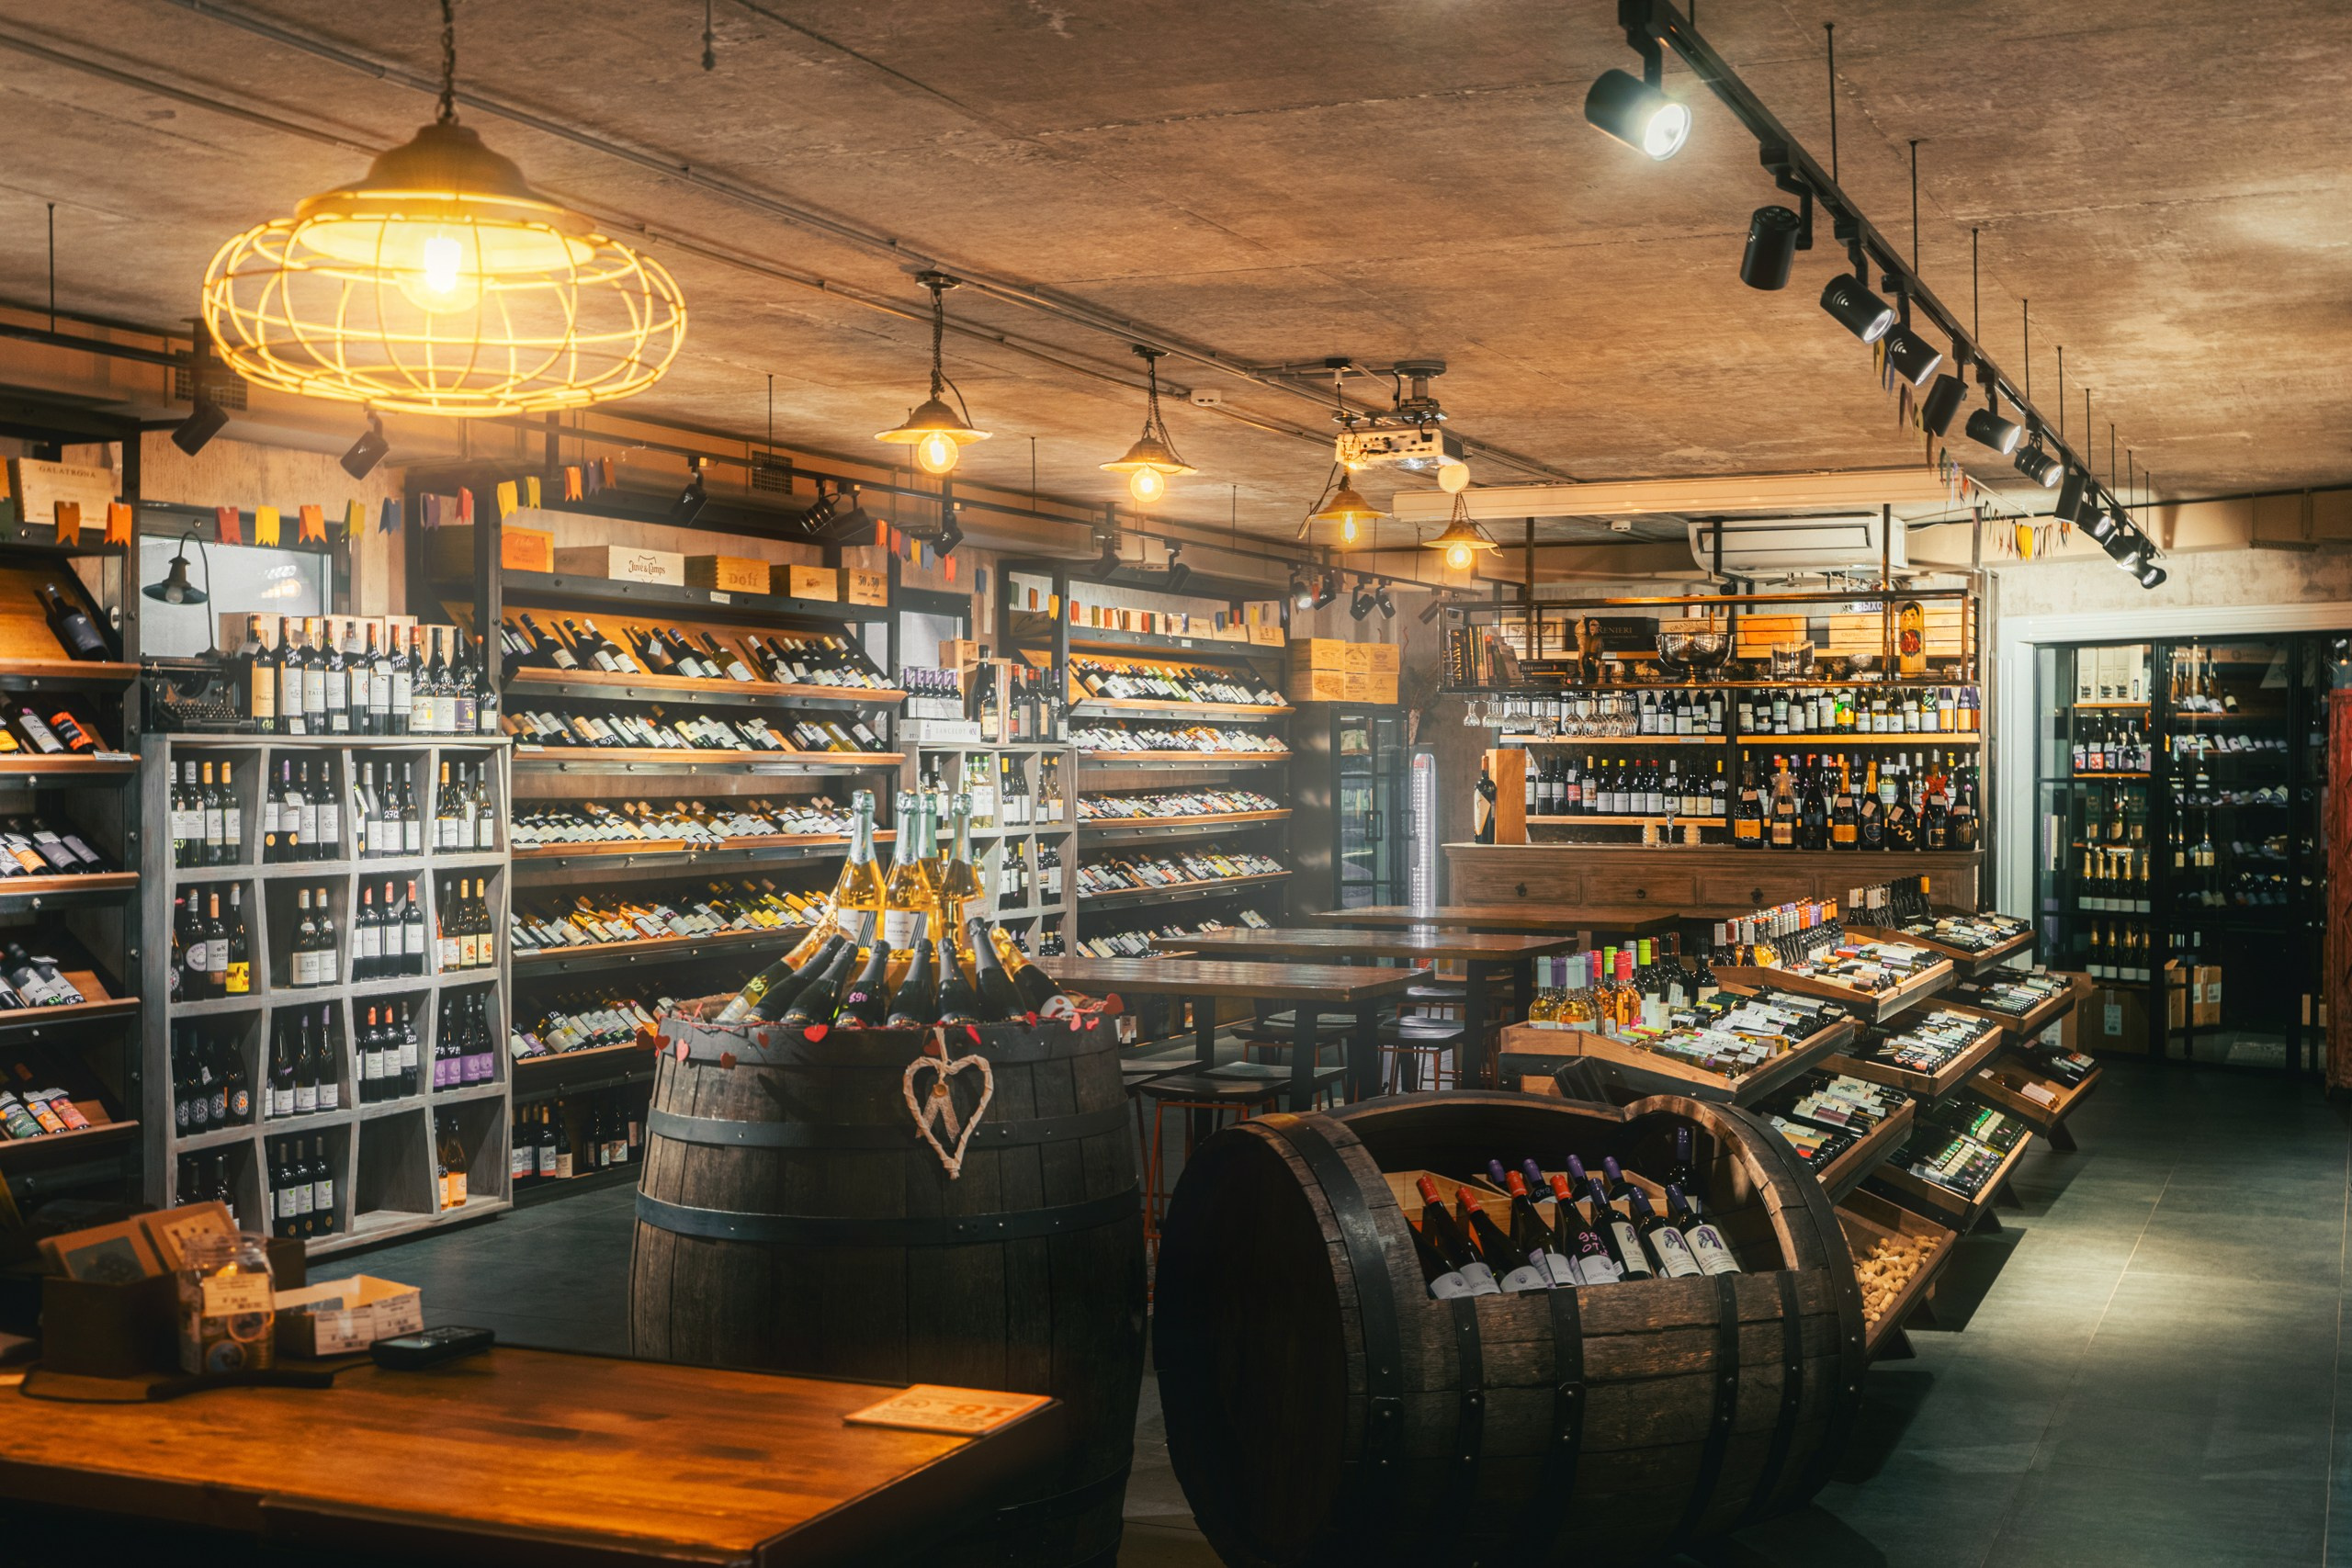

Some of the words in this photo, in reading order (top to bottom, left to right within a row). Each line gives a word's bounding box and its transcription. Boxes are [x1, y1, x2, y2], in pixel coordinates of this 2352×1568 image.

[40, 465, 96, 479] GALATRONA
[648, 561, 666, 576] Camps
[1855, 601, 1883, 612] ВЫХО
